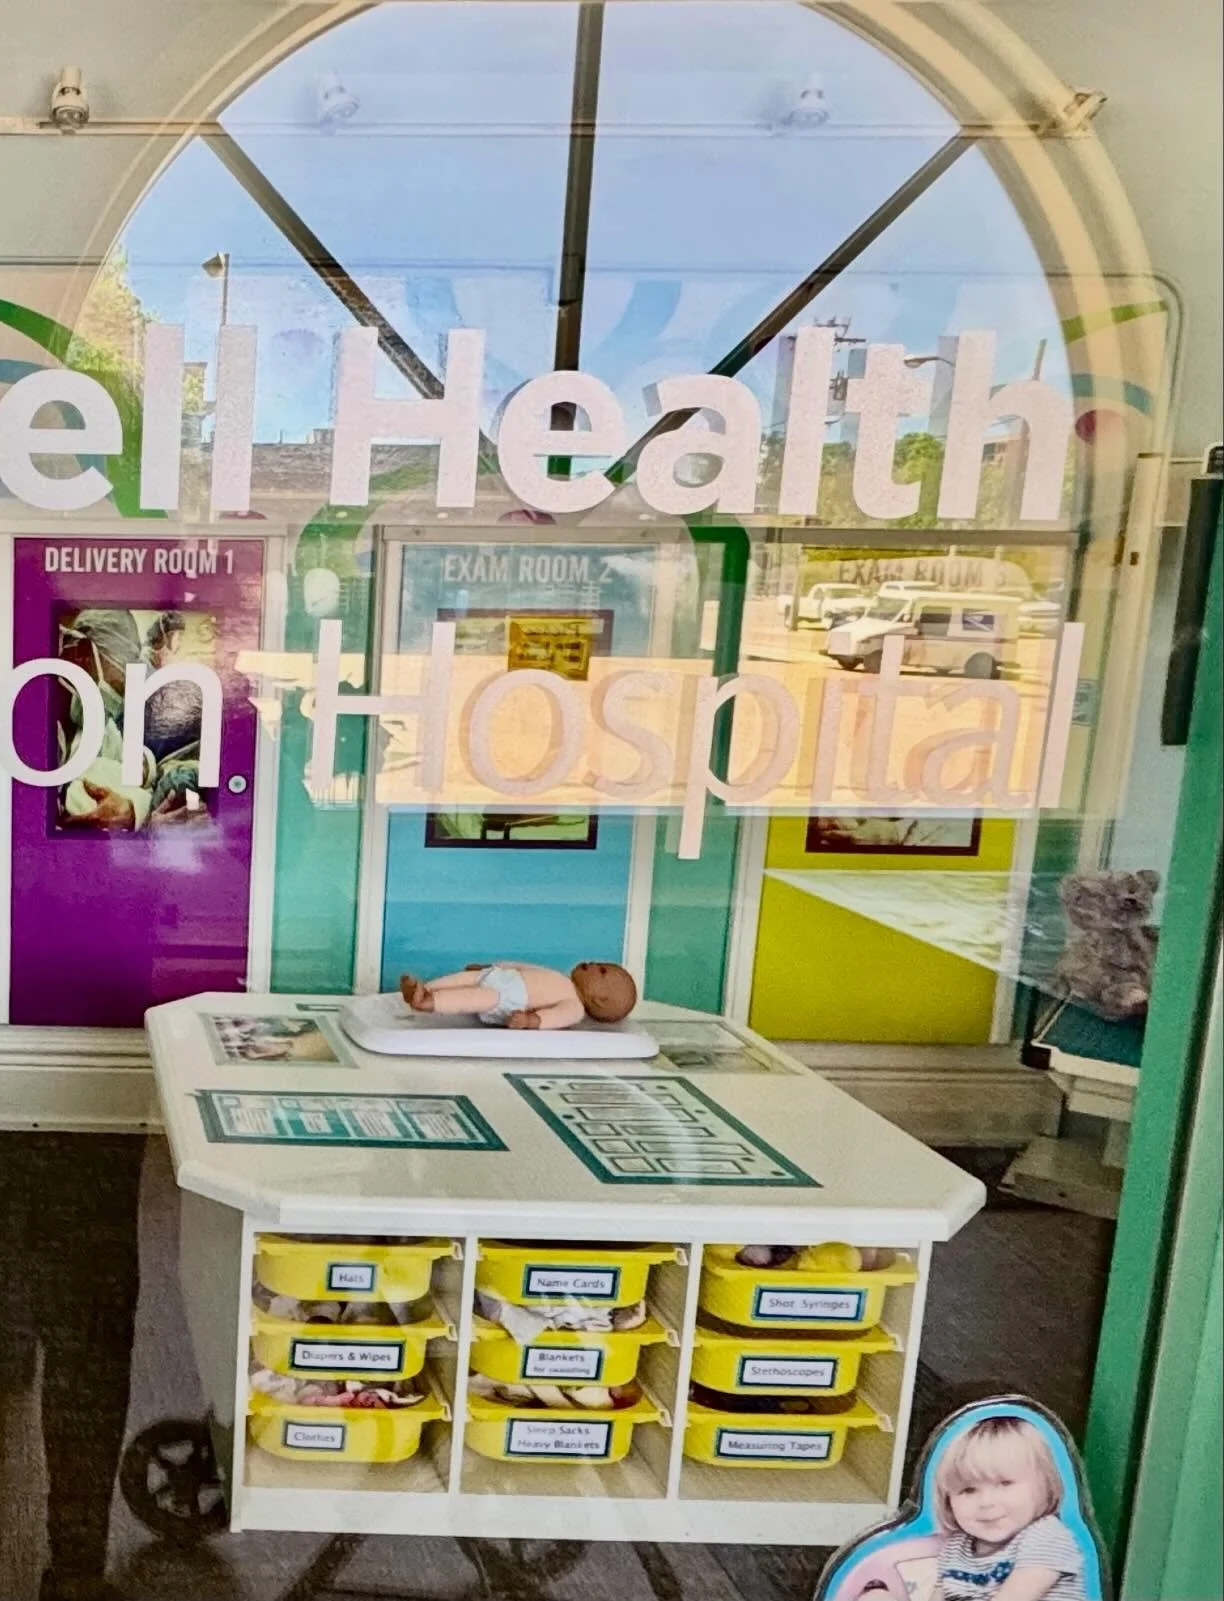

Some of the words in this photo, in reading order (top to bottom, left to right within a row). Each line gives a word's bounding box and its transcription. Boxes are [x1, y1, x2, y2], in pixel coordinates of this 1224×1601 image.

[329, 325, 1076, 522] Health
[44, 546, 147, 574] DELIVERY
[154, 548, 217, 575] ROOM
[224, 549, 234, 575] 1
[443, 554, 510, 583] EXAM
[519, 555, 590, 584] ROOM
[304, 618, 1085, 859] Hospital
[338, 1272, 365, 1284] Hats
[537, 1278, 569, 1288] Name
[573, 1279, 606, 1289] Cards
[769, 1298, 795, 1309] Shot
[802, 1299, 850, 1311] Syringes
[301, 1350, 344, 1362] Diapers
[347, 1351, 357, 1362] &
[359, 1351, 391, 1363] Wipes
[538, 1352, 586, 1362] Blankets
[751, 1365, 825, 1378] Stethoscopes
[526, 1425, 556, 1436] Sleep
[559, 1425, 590, 1436] Sacks
[293, 1431, 336, 1443] Clothes
[517, 1440, 551, 1450] Heavy
[554, 1440, 600, 1450] Blankets
[728, 1440, 786, 1452] Measuring
[790, 1441, 823, 1451] Tapes
